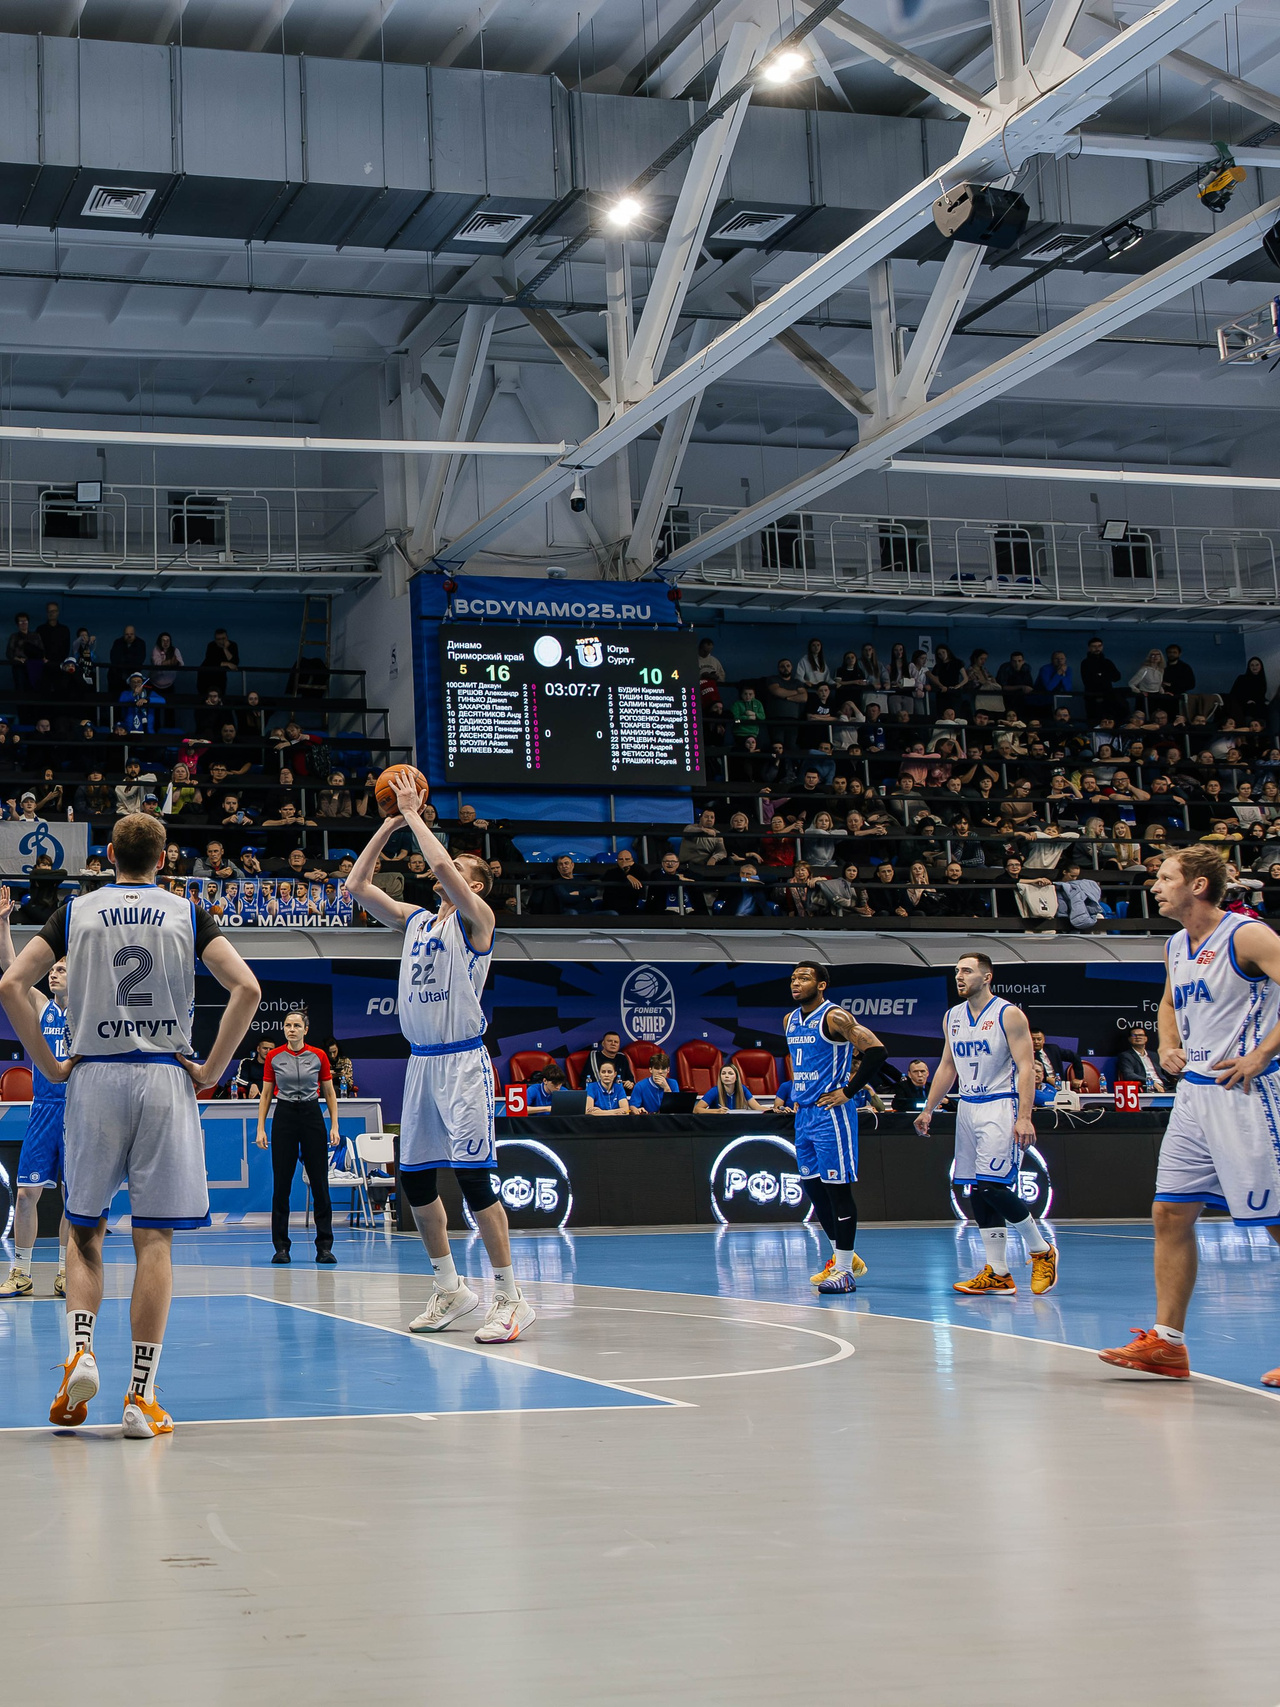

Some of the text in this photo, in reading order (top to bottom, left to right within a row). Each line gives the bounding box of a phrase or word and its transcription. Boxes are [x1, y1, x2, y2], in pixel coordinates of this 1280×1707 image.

[454, 598, 651, 620] BCDYNAMO25.RU
[447, 641, 482, 650] Динамо
[607, 645, 630, 654] Югра
[447, 652, 524, 662] Приморский край
[565, 655, 573, 670] 1
[607, 656, 635, 665] Сургут
[459, 664, 511, 682] 5 16
[639, 667, 679, 685] 10 4
[545, 682, 600, 697] 03:07:7
[97, 907, 166, 927] ТИШИН
[258, 914, 348, 927] МАШИНА!
[113, 945, 153, 1007] 2
[411, 963, 436, 985] 22
[260, 998, 306, 1012] onbet
[367, 997, 399, 1015] FO
[634, 1006, 663, 1014] FONBET
[840, 998, 918, 1016] FONBET
[97, 1019, 177, 1039] СУРГУТ
[632, 1015, 666, 1033] СУПЕР
[953, 1040, 991, 1057] ЮГРА
[969, 1062, 979, 1081] 7
[508, 1087, 525, 1113] 5
[1114, 1085, 1138, 1109] 55
[725, 1167, 804, 1207] РФБ
[131, 1344, 155, 1398] ELITE
